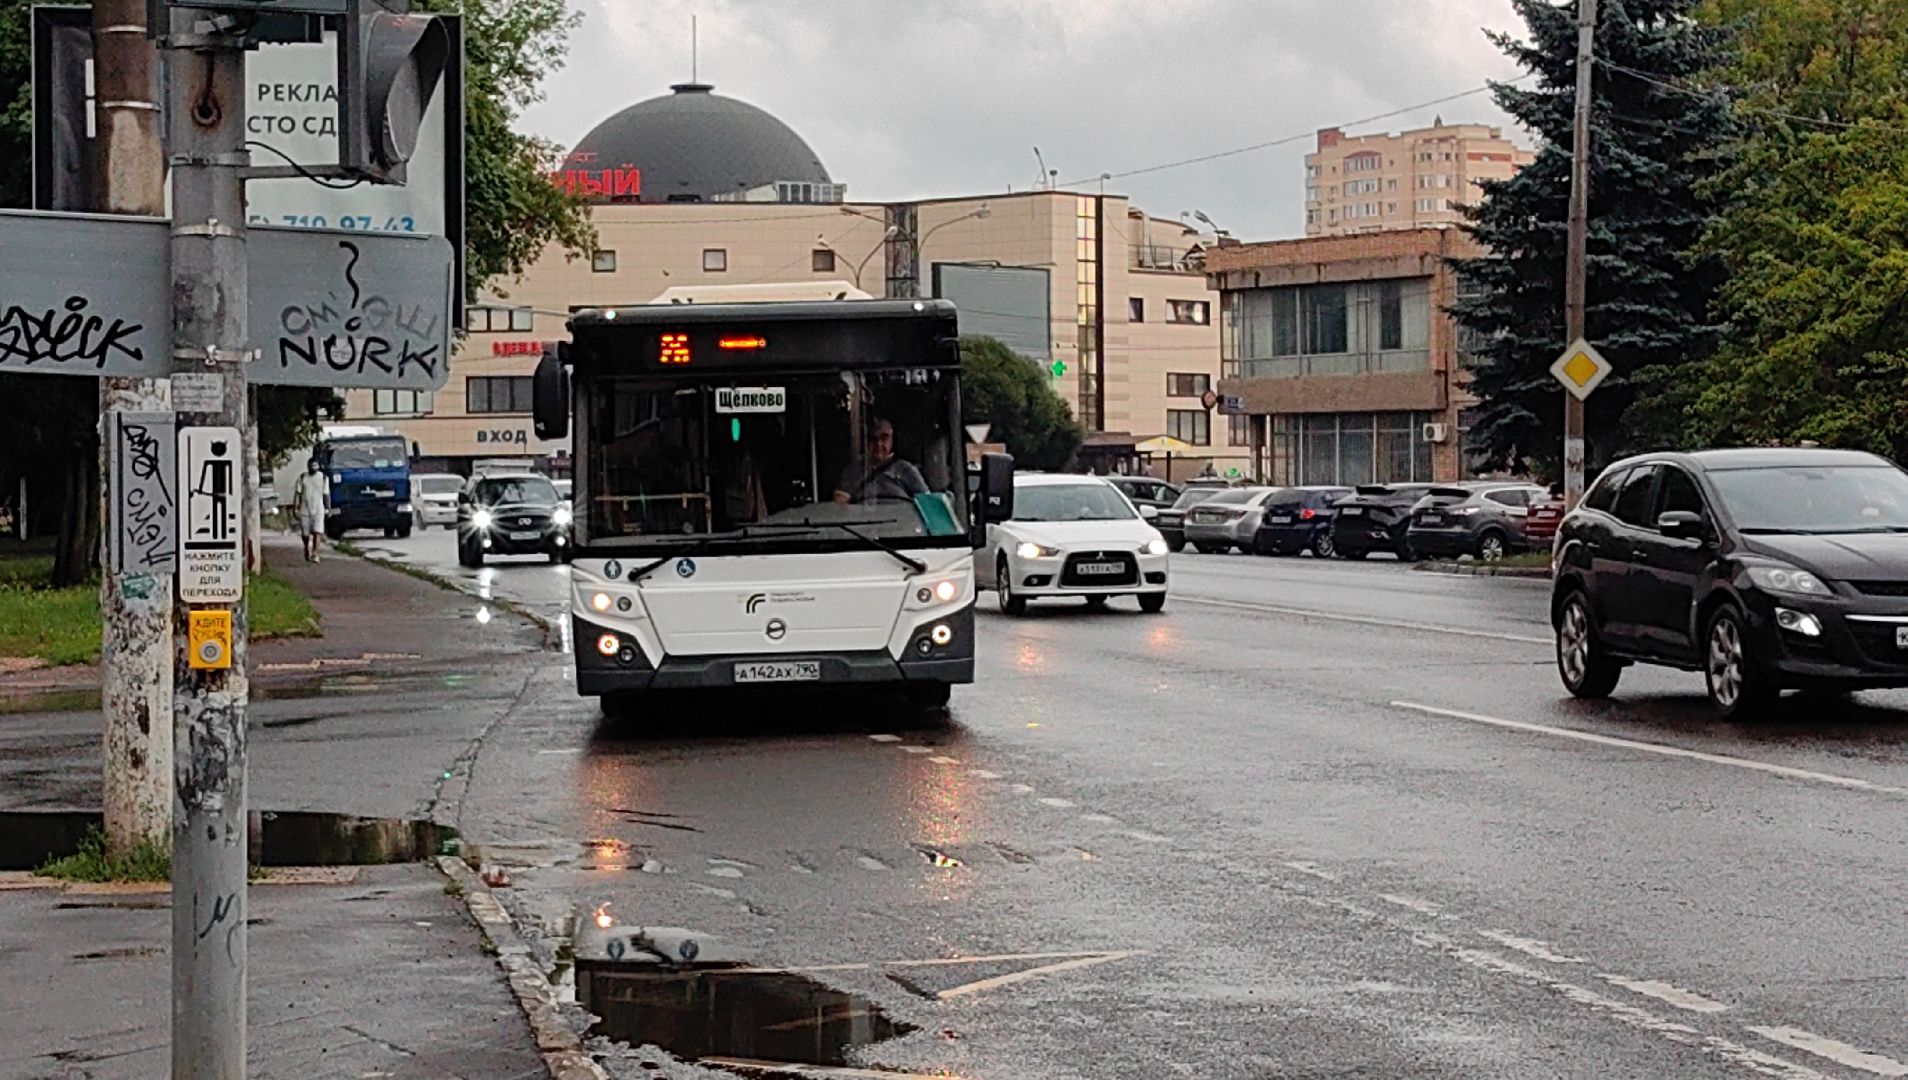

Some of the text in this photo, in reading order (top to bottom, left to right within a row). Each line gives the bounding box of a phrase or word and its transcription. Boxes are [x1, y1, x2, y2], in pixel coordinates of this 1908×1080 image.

[247, 115, 296, 134] СТО
[477, 429, 528, 445] ВХОД
[190, 564, 231, 572] КНОПКУ
[199, 576, 221, 585] ДЛЯ
[182, 588, 238, 597] ПЕРЕХОДА
